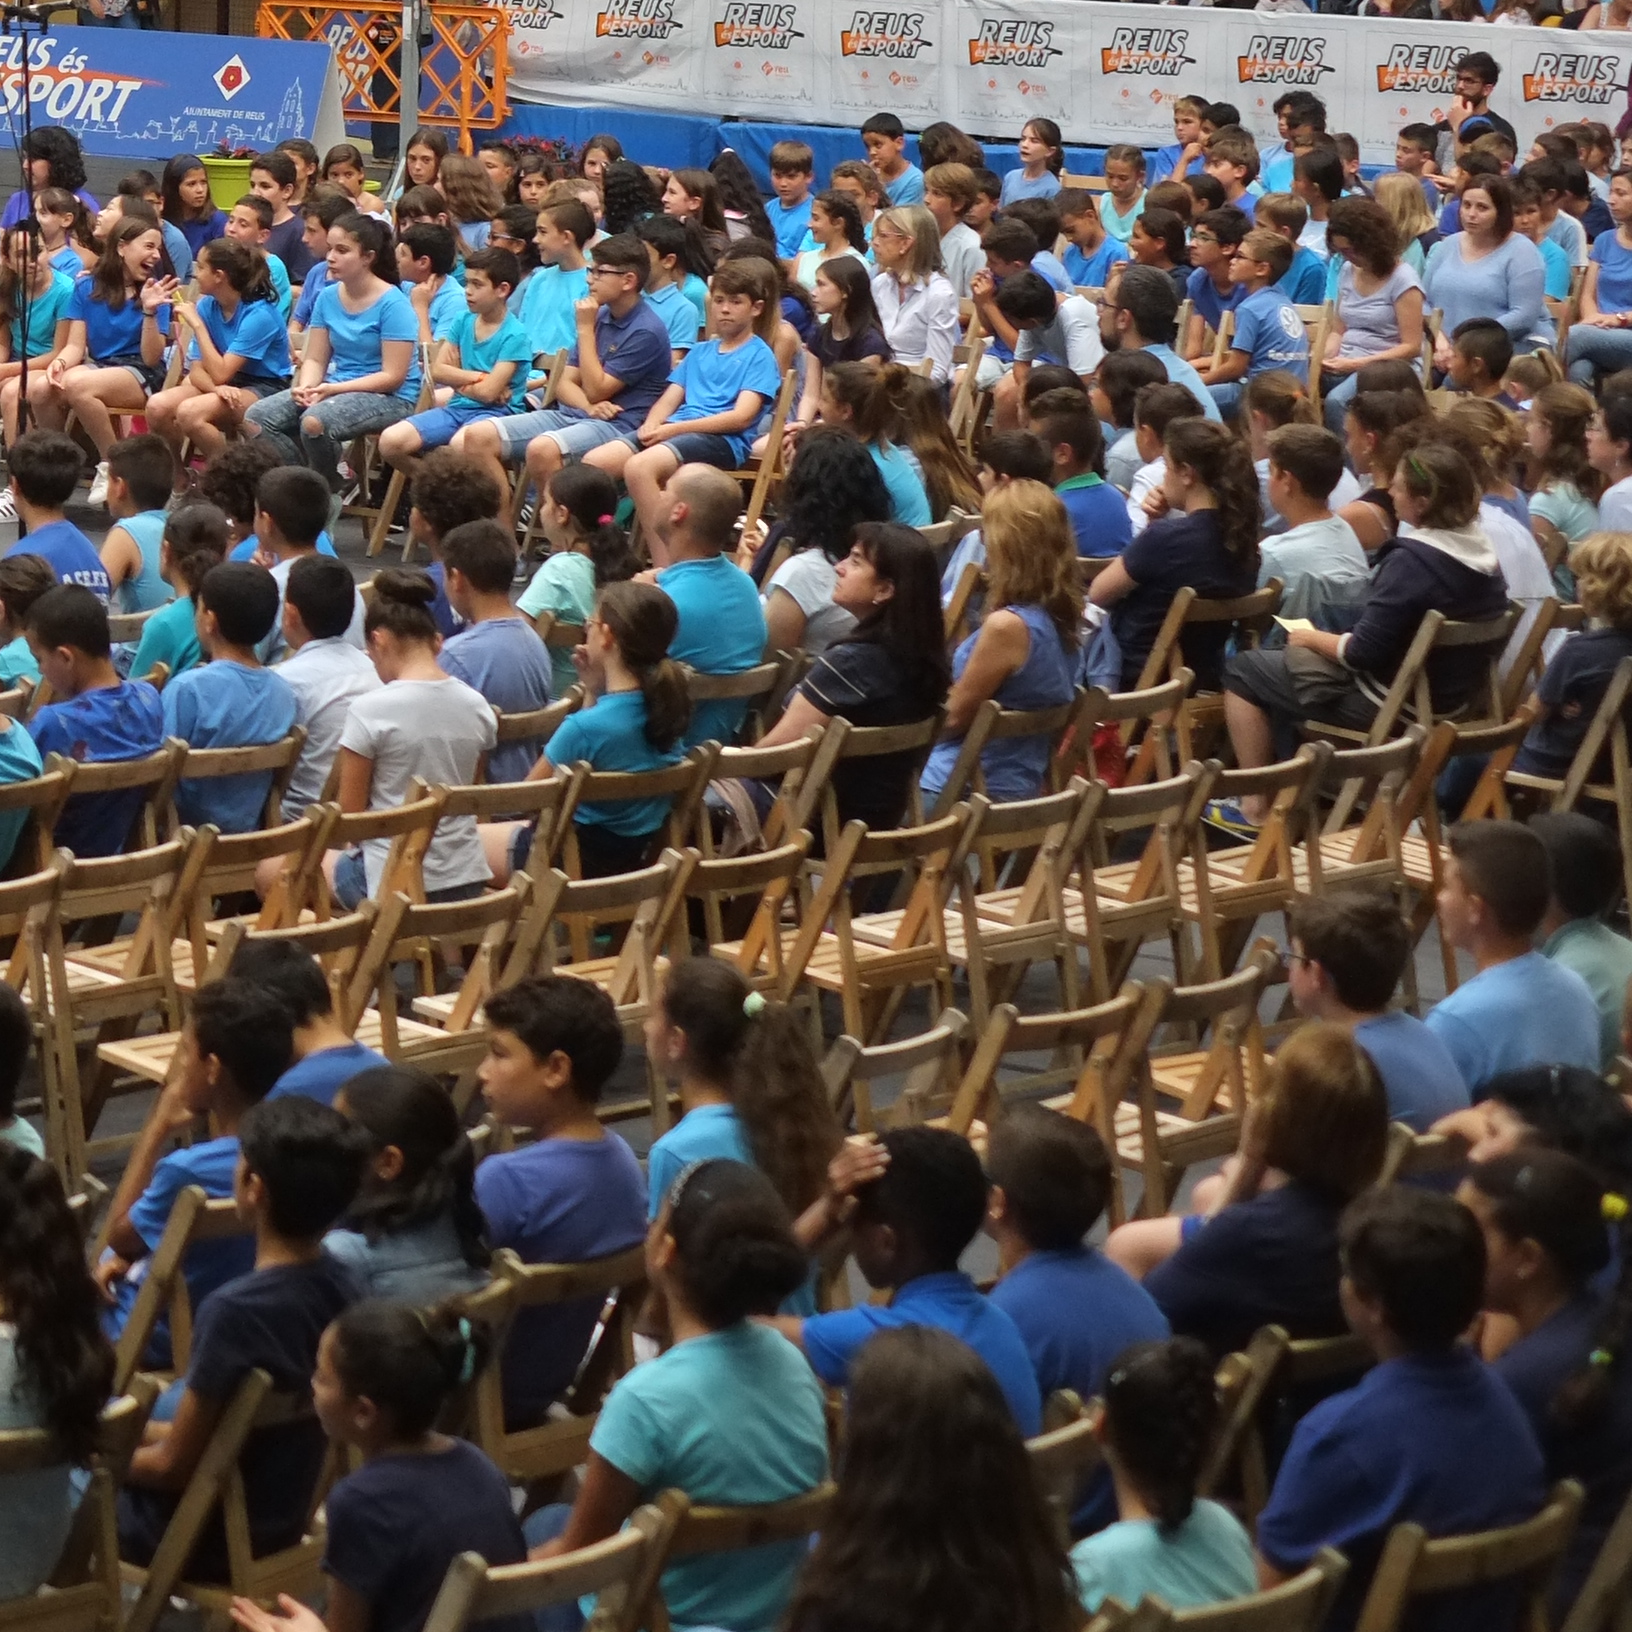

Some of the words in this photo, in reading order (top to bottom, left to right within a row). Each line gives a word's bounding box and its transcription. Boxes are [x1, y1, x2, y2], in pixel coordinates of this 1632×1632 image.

[725, 3, 796, 31] REUS
[610, 19, 674, 39] ESPORT
[730, 30, 794, 49] ESPORT
[979, 19, 1054, 49] REUS
[59, 46, 88, 72] és
[984, 47, 1053, 67] ESPORT
[1247, 35, 1325, 66] REUS
[1254, 65, 1324, 85] ESPORT
[1535, 53, 1619, 84] REUS
[1541, 83, 1616, 104] ESPORT
[183, 105, 232, 120] AJUNTAMENT
[232, 109, 244, 120] DE
[244, 110, 266, 122] REUS
